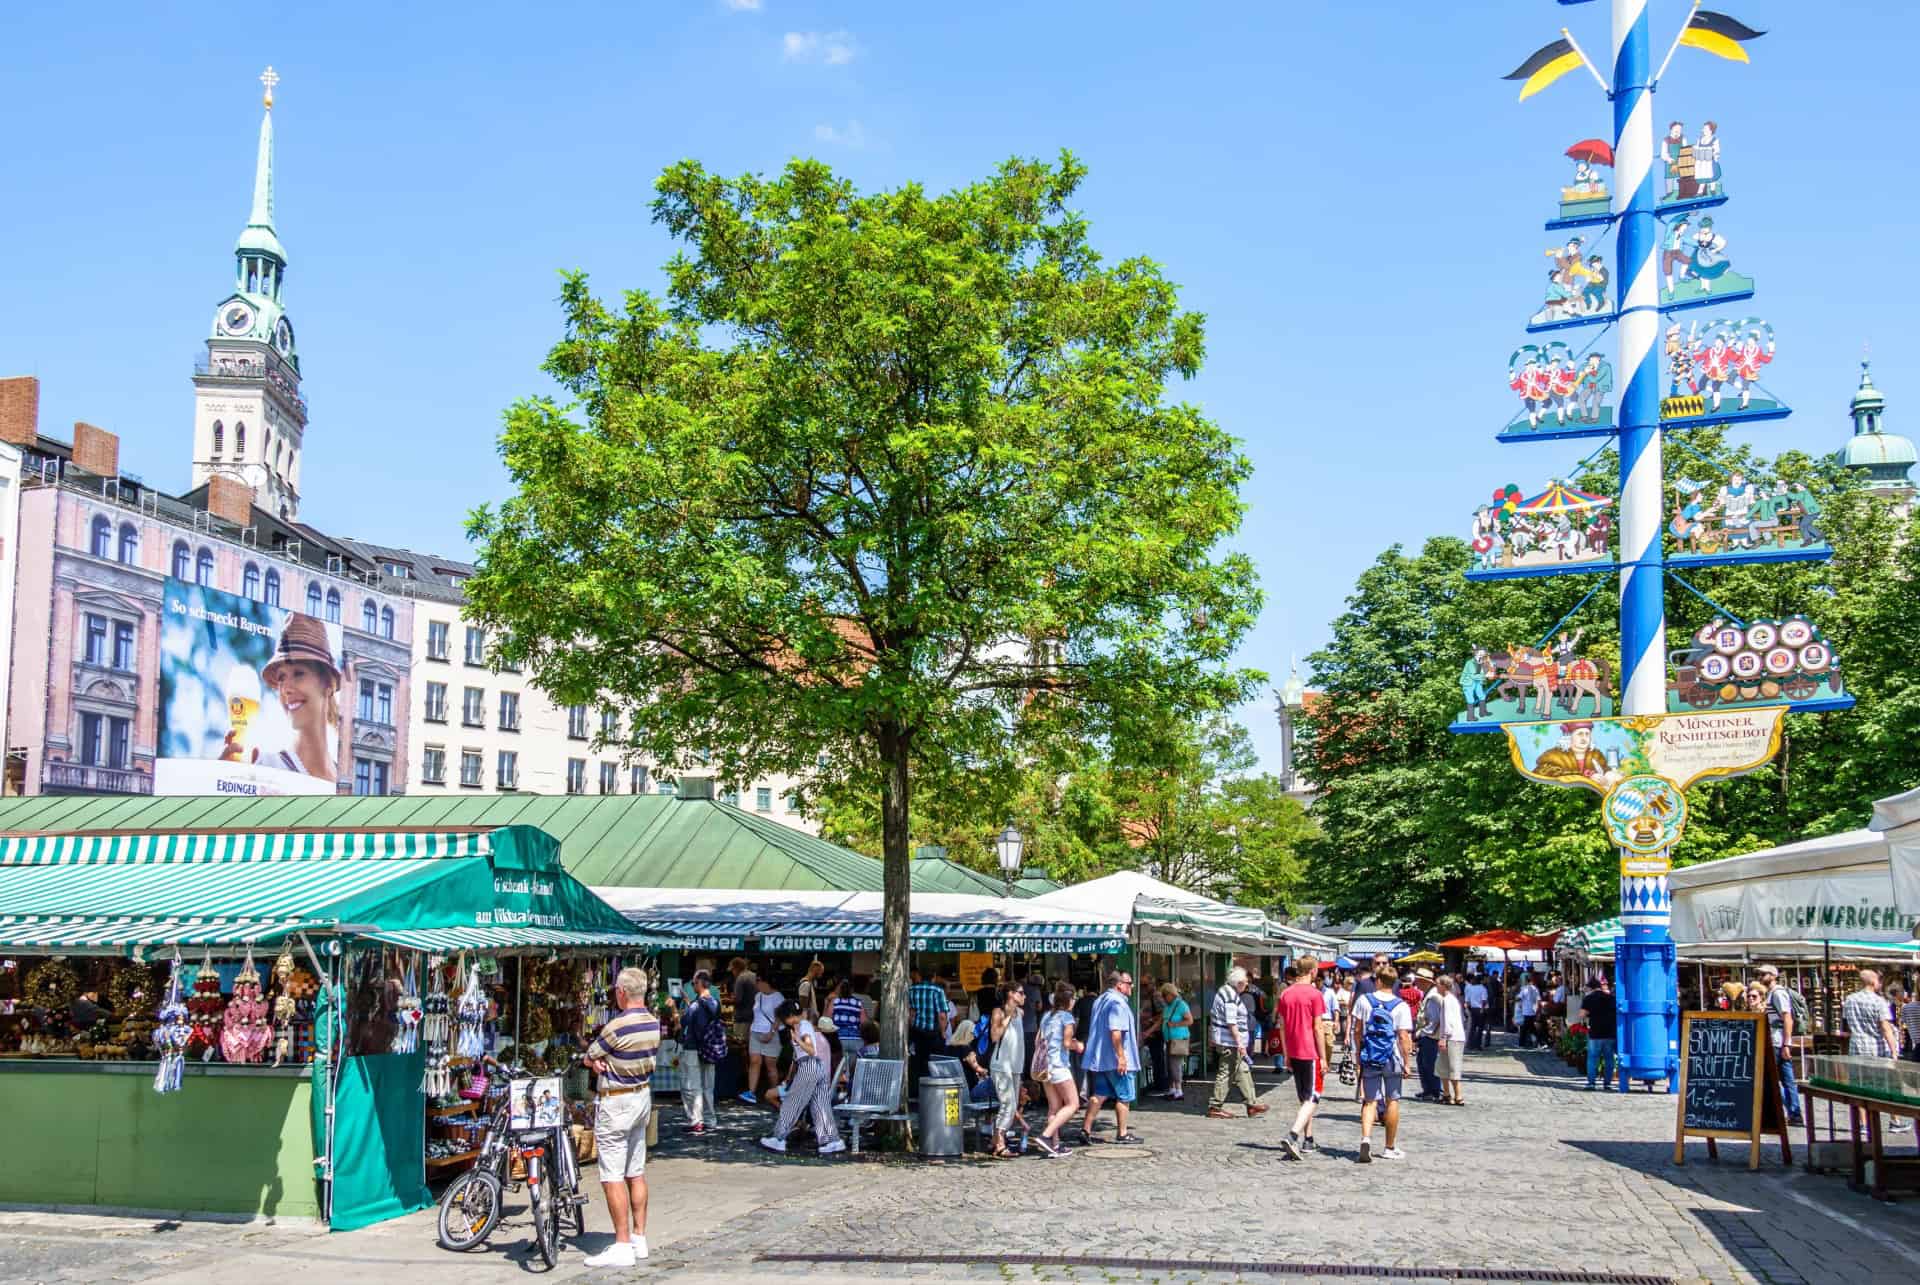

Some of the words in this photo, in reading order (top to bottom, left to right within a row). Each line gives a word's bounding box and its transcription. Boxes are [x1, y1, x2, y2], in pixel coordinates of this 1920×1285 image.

[171, 600, 187, 614] So
[189, 606, 238, 628] schmeckt
[216, 779, 257, 795] ERDINGER
[475, 911, 492, 924] am
[764, 936, 831, 951] Kräuter
[835, 937, 848, 951] &
[852, 937, 928, 951] Gewze
[985, 939, 1002, 953] DIE
[1044, 939, 1074, 953] ECKE
[1689, 1029, 1752, 1056] SOMMER
